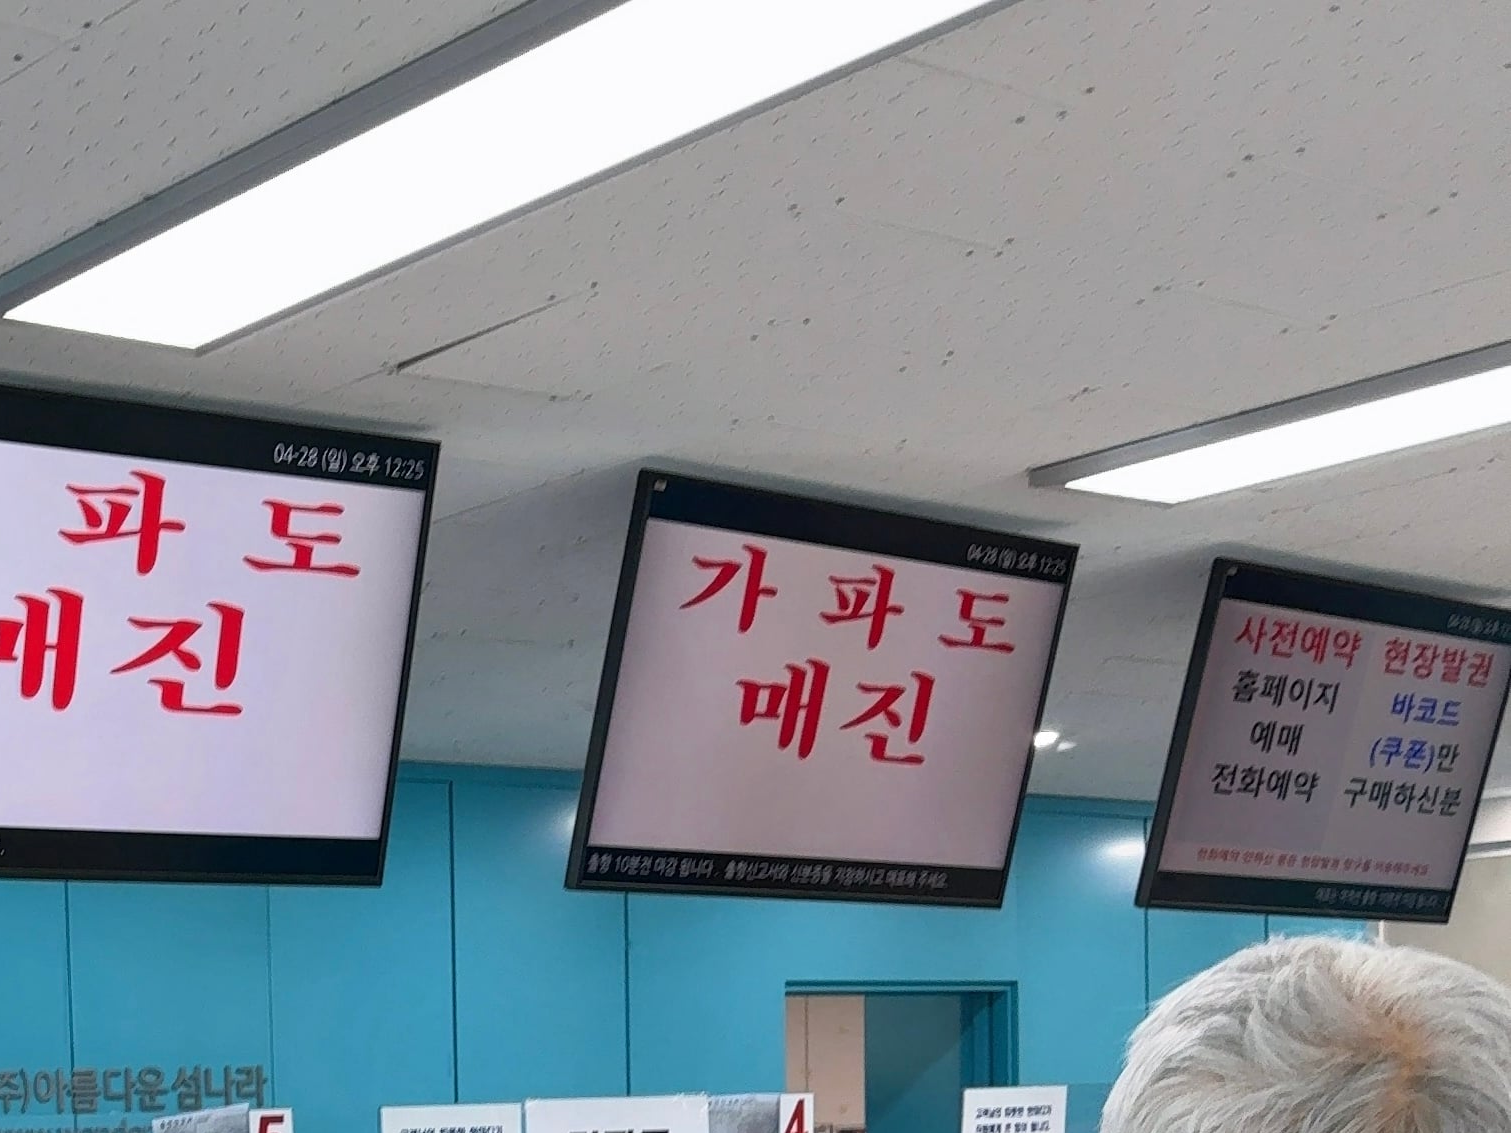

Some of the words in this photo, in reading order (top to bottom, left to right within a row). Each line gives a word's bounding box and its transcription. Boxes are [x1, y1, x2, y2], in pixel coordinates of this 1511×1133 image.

[274, 443, 318, 467] 04-28
[349, 452, 380, 476] 오후
[385, 457, 424, 480] 12:25
[1234, 615, 1362, 670] 사전예약
[1384, 638, 1495, 689] 현장발권
[736, 658, 935, 766] 매진
[1232, 669, 1341, 715] 홈페이지
[1390, 692, 1462, 726] 바코드
[1250, 720, 1305, 757] 예매
[1211, 762, 1319, 804] 전화예약
[1344, 776, 1462, 817] 구매하신분
